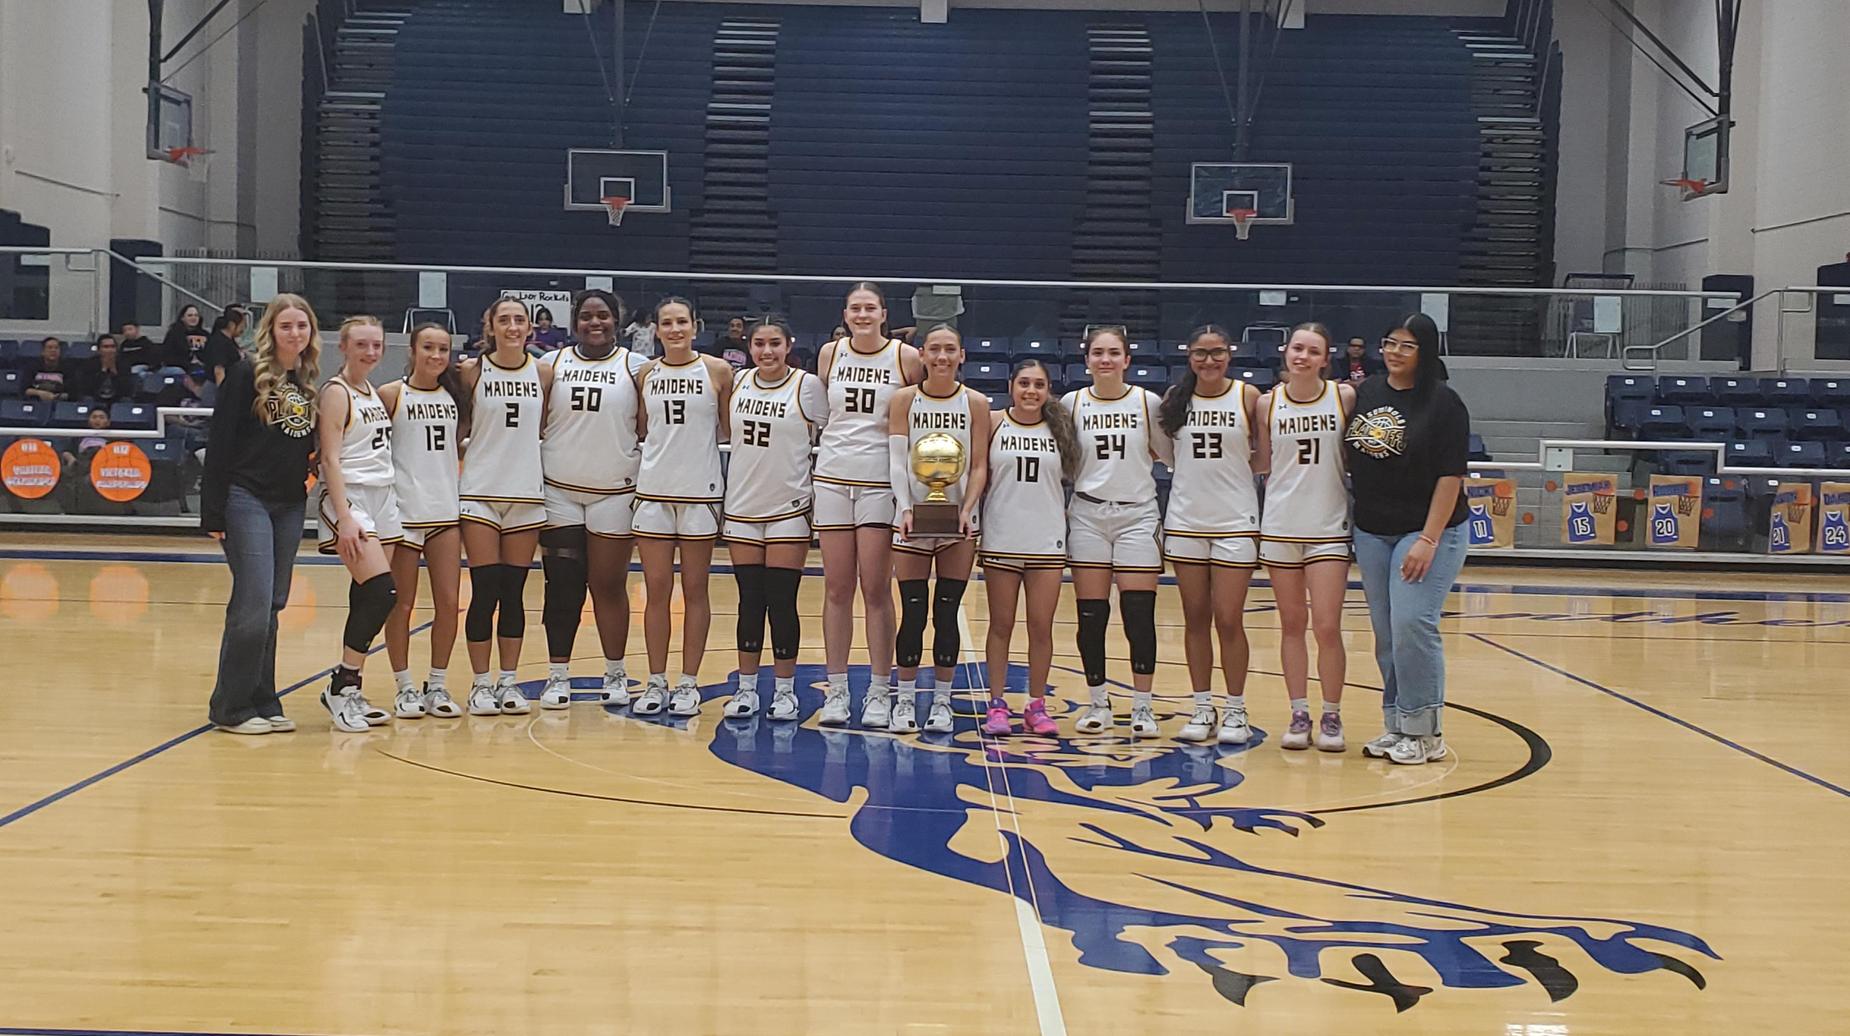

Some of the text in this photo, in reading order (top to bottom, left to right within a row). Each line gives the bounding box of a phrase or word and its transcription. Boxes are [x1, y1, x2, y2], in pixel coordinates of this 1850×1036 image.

[562, 369, 617, 385] MAIDENS
[837, 367, 891, 386] MAIDENS
[484, 381, 538, 398] MAIDENS
[650, 379, 704, 395] MAIDENS
[570, 386, 603, 413] 50
[735, 397, 787, 419] MAIDENS
[845, 387, 876, 414] 30
[406, 404, 457, 421] MAIDENS
[505, 403, 519, 429] 2
[663, 400, 686, 425] 13
[912, 412, 966, 430] MAIDENS
[1082, 413, 1137, 431] MAIDENS
[743, 420, 772, 448] 32
[1278, 414, 1337, 436] MAIDENS
[424, 425, 446, 451] 12
[1000, 435, 1056, 453] MAIDENS
[1094, 434, 1126, 460] 24
[1190, 432, 1223, 459] 23
[1296, 438, 1320, 465] 21
[1016, 456, 1040, 483] 10
[1473, 520, 1487, 538] 11
[1574, 517, 1590, 535] 15
[1655, 519, 1675, 536] 20
[1826, 526, 1847, 545] 24
